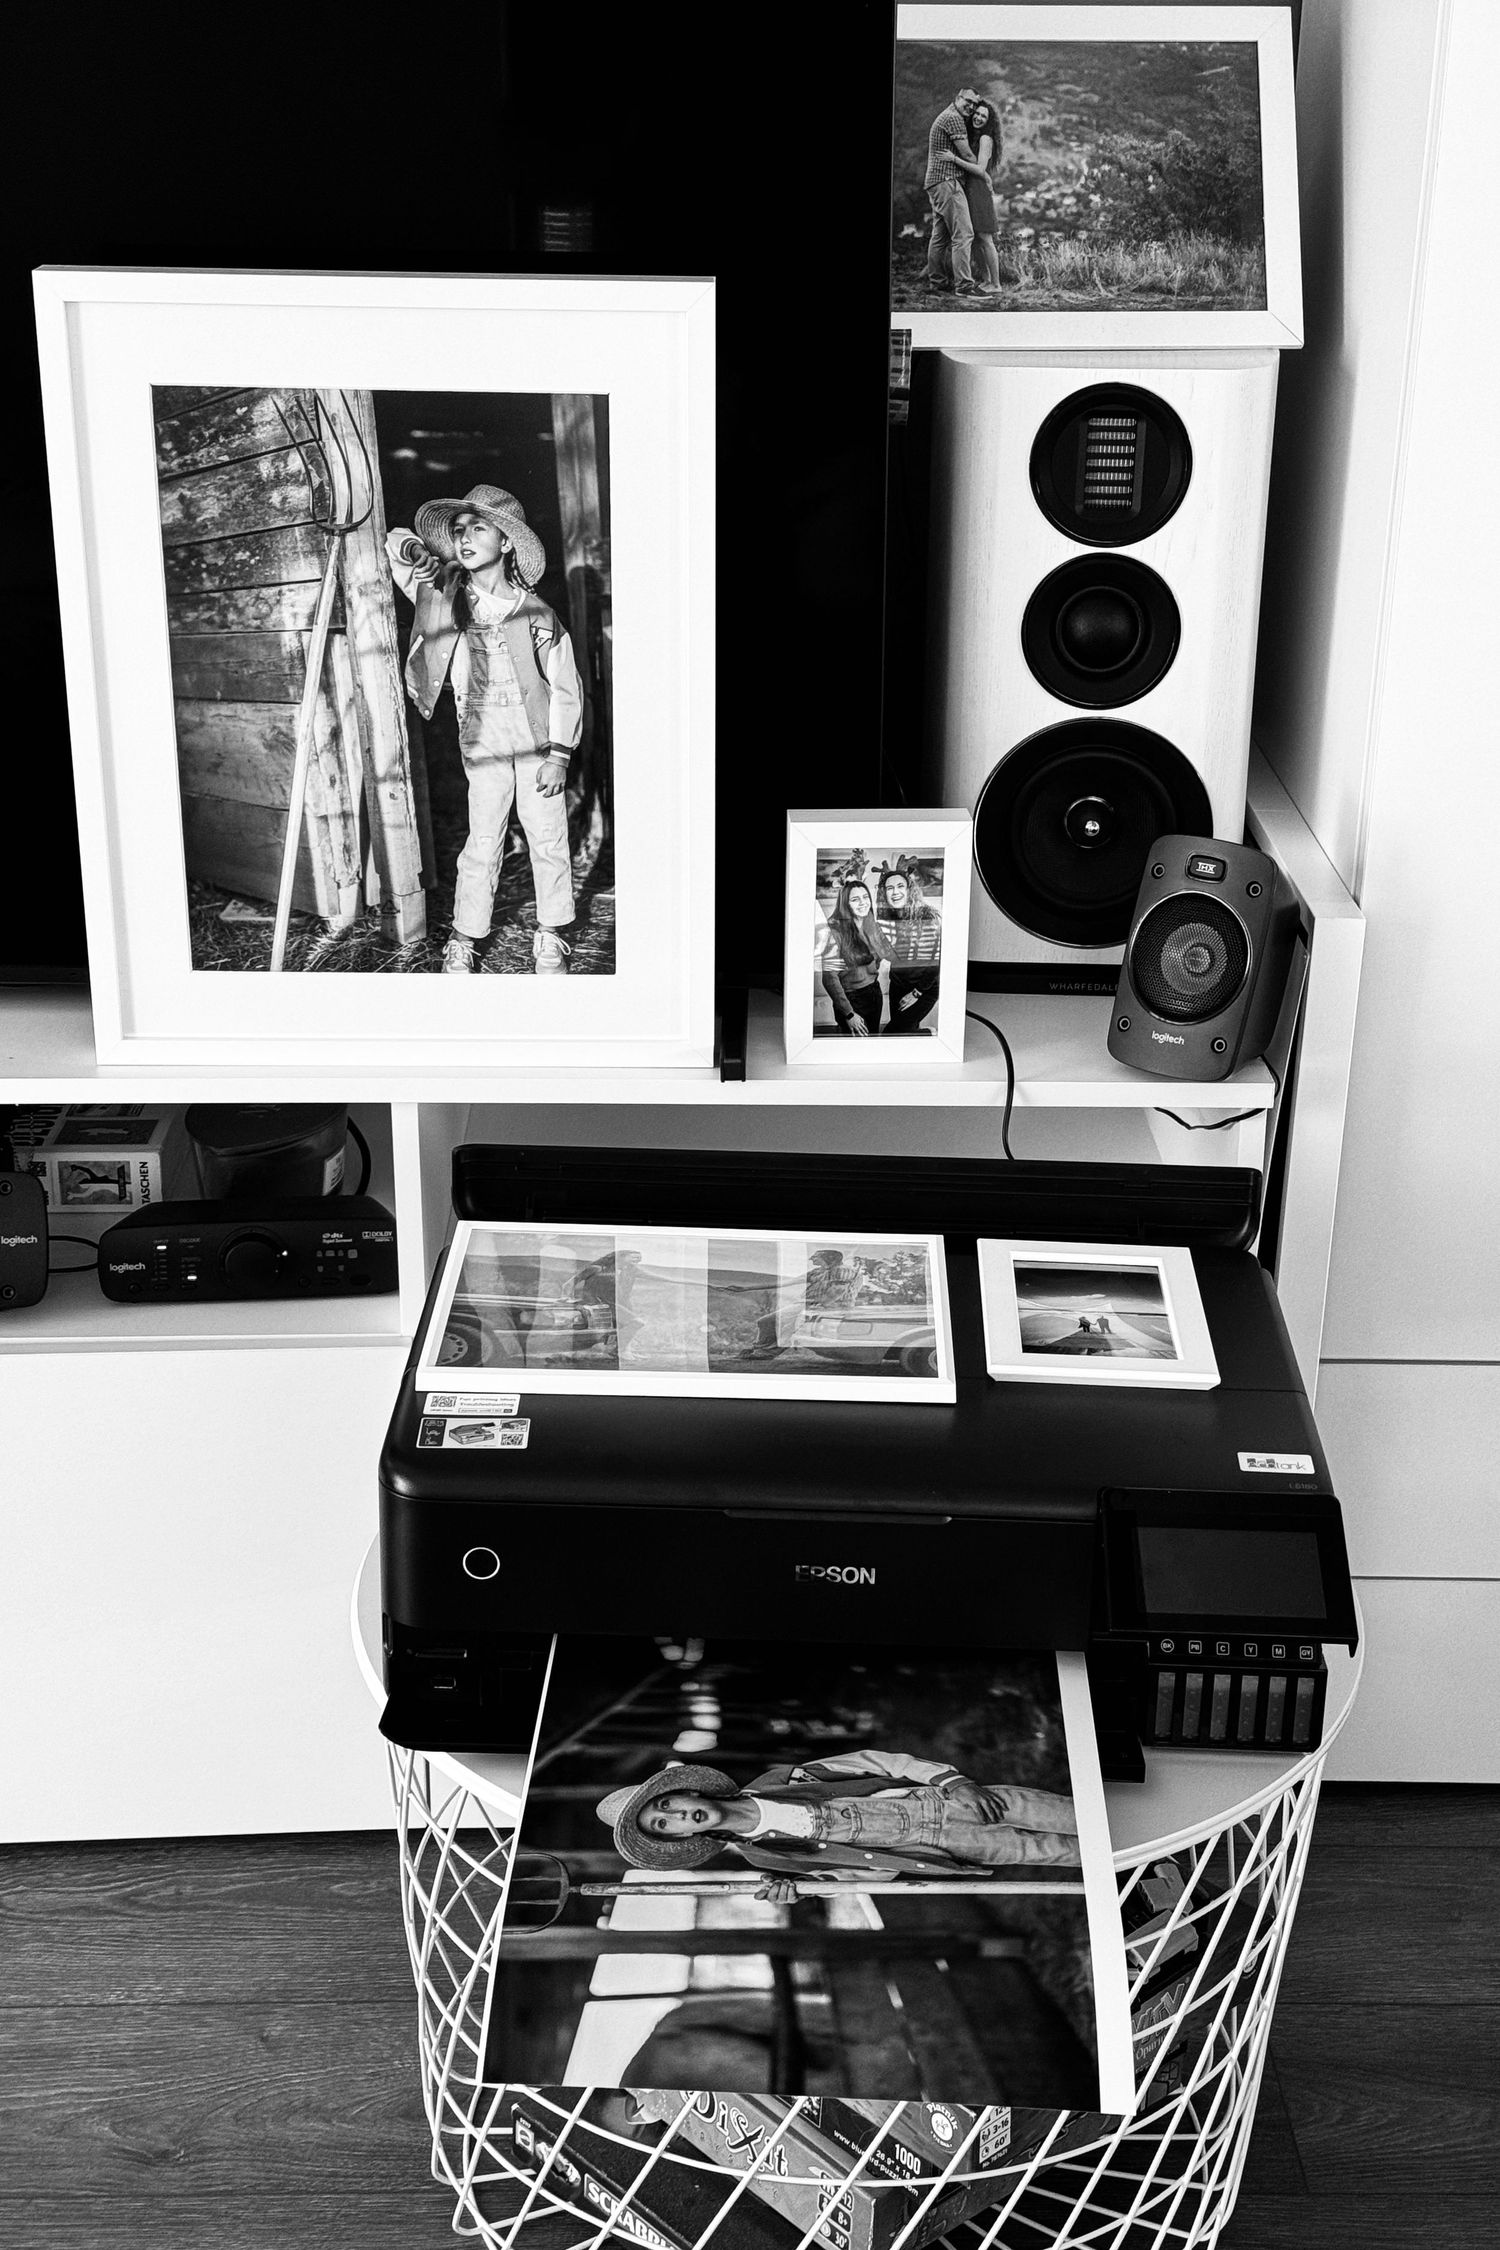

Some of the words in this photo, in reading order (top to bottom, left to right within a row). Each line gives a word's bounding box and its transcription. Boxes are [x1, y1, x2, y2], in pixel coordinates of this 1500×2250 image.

[1196, 862, 1216, 874] THX
[1152, 1031, 1184, 1045] logitech
[139, 1161, 150, 1204] TASCHEN
[1, 1235, 37, 1245] logitech
[109, 1262, 146, 1273] logitech
[795, 1564, 876, 1585] EPSON
[993, 2117, 1009, 2134] 3-16
[895, 2143, 921, 2175] 1000
[838, 2211, 848, 2226] 8+
